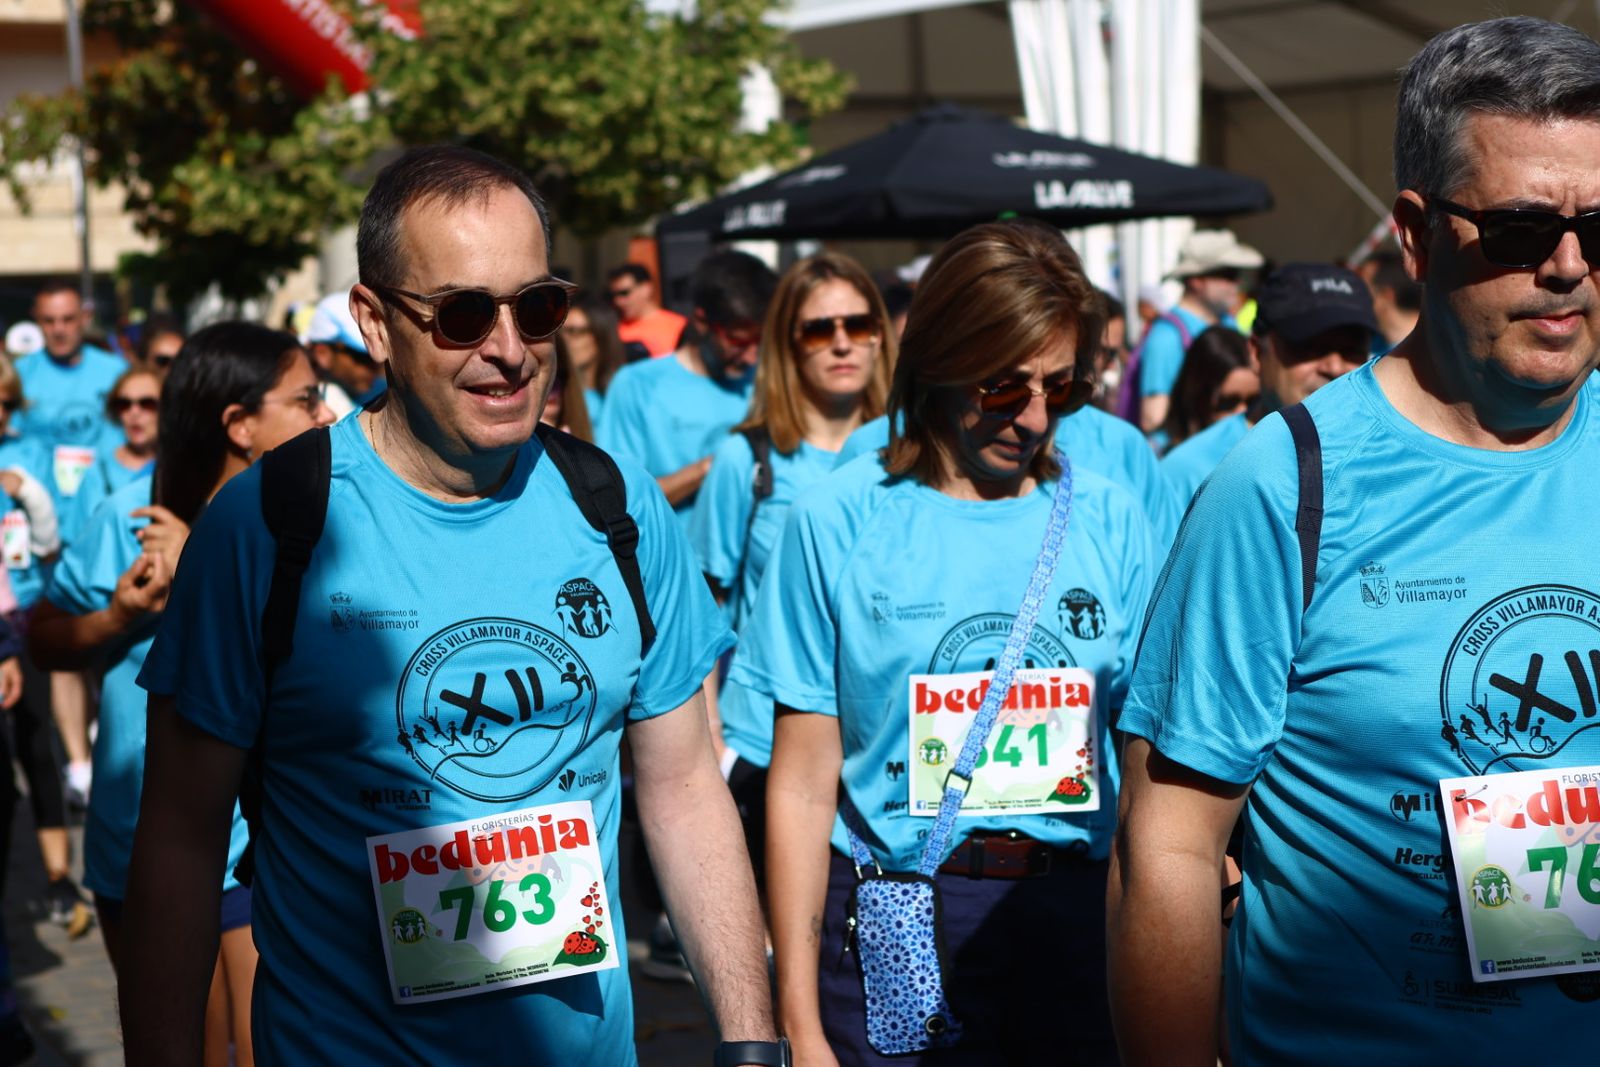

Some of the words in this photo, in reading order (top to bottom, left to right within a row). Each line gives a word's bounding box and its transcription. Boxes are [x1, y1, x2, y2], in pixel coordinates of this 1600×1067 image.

[560, 582, 595, 594] ASPACE
[1394, 577, 1453, 590] Ayuntamiento
[1456, 575, 1466, 585] de
[1396, 587, 1467, 604] Villamayor
[359, 609, 407, 619] Ayuntamiento
[409, 608, 418, 617] de
[897, 610, 946, 622] Villamayor
[360, 617, 419, 631] Villamayor
[1462, 616, 1500, 657] CROSS
[1496, 595, 1585, 623] VILLAMAYOR
[415, 642, 449, 677] CROSS
[447, 625, 521, 649] VILLAMAYOR
[524, 627, 568, 664] ASPACE
[942, 633, 965, 662] CROSS
[1030, 632, 1061, 661] SPACE
[439, 666, 544, 736] XII
[578, 769, 607, 788] Unicaja
[471, 813, 534, 833] FLORISTERÍAS
[374, 813, 591, 885] bedunia
[1526, 843, 1600, 910] 76
[438, 872, 557, 942] 763
